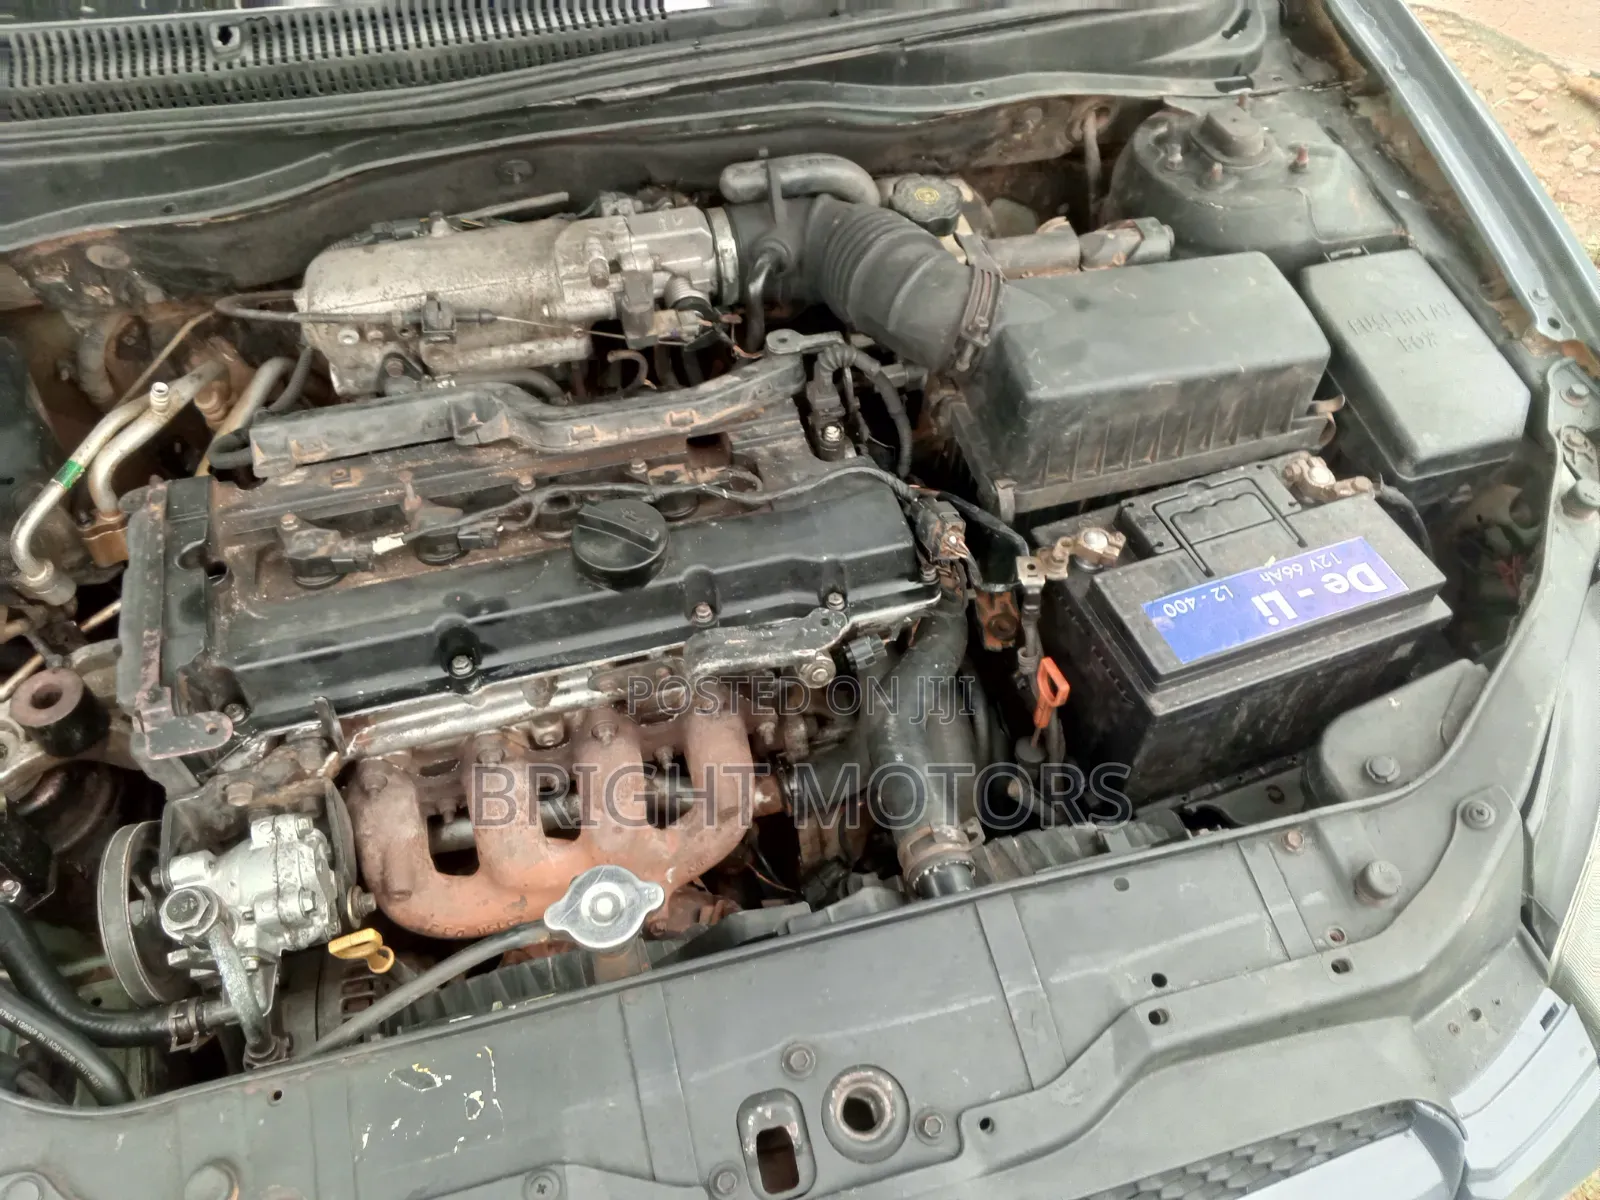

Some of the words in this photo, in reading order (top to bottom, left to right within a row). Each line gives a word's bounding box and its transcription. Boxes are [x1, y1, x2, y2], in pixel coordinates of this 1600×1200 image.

[1309, 551, 1342, 573] 12V
[1260, 563, 1304, 586] 66Ah
[1320, 562, 1388, 593] De
[1210, 585, 1234, 602] L2
[1163, 597, 1196, 617] 400
[1251, 590, 1298, 625] Li
